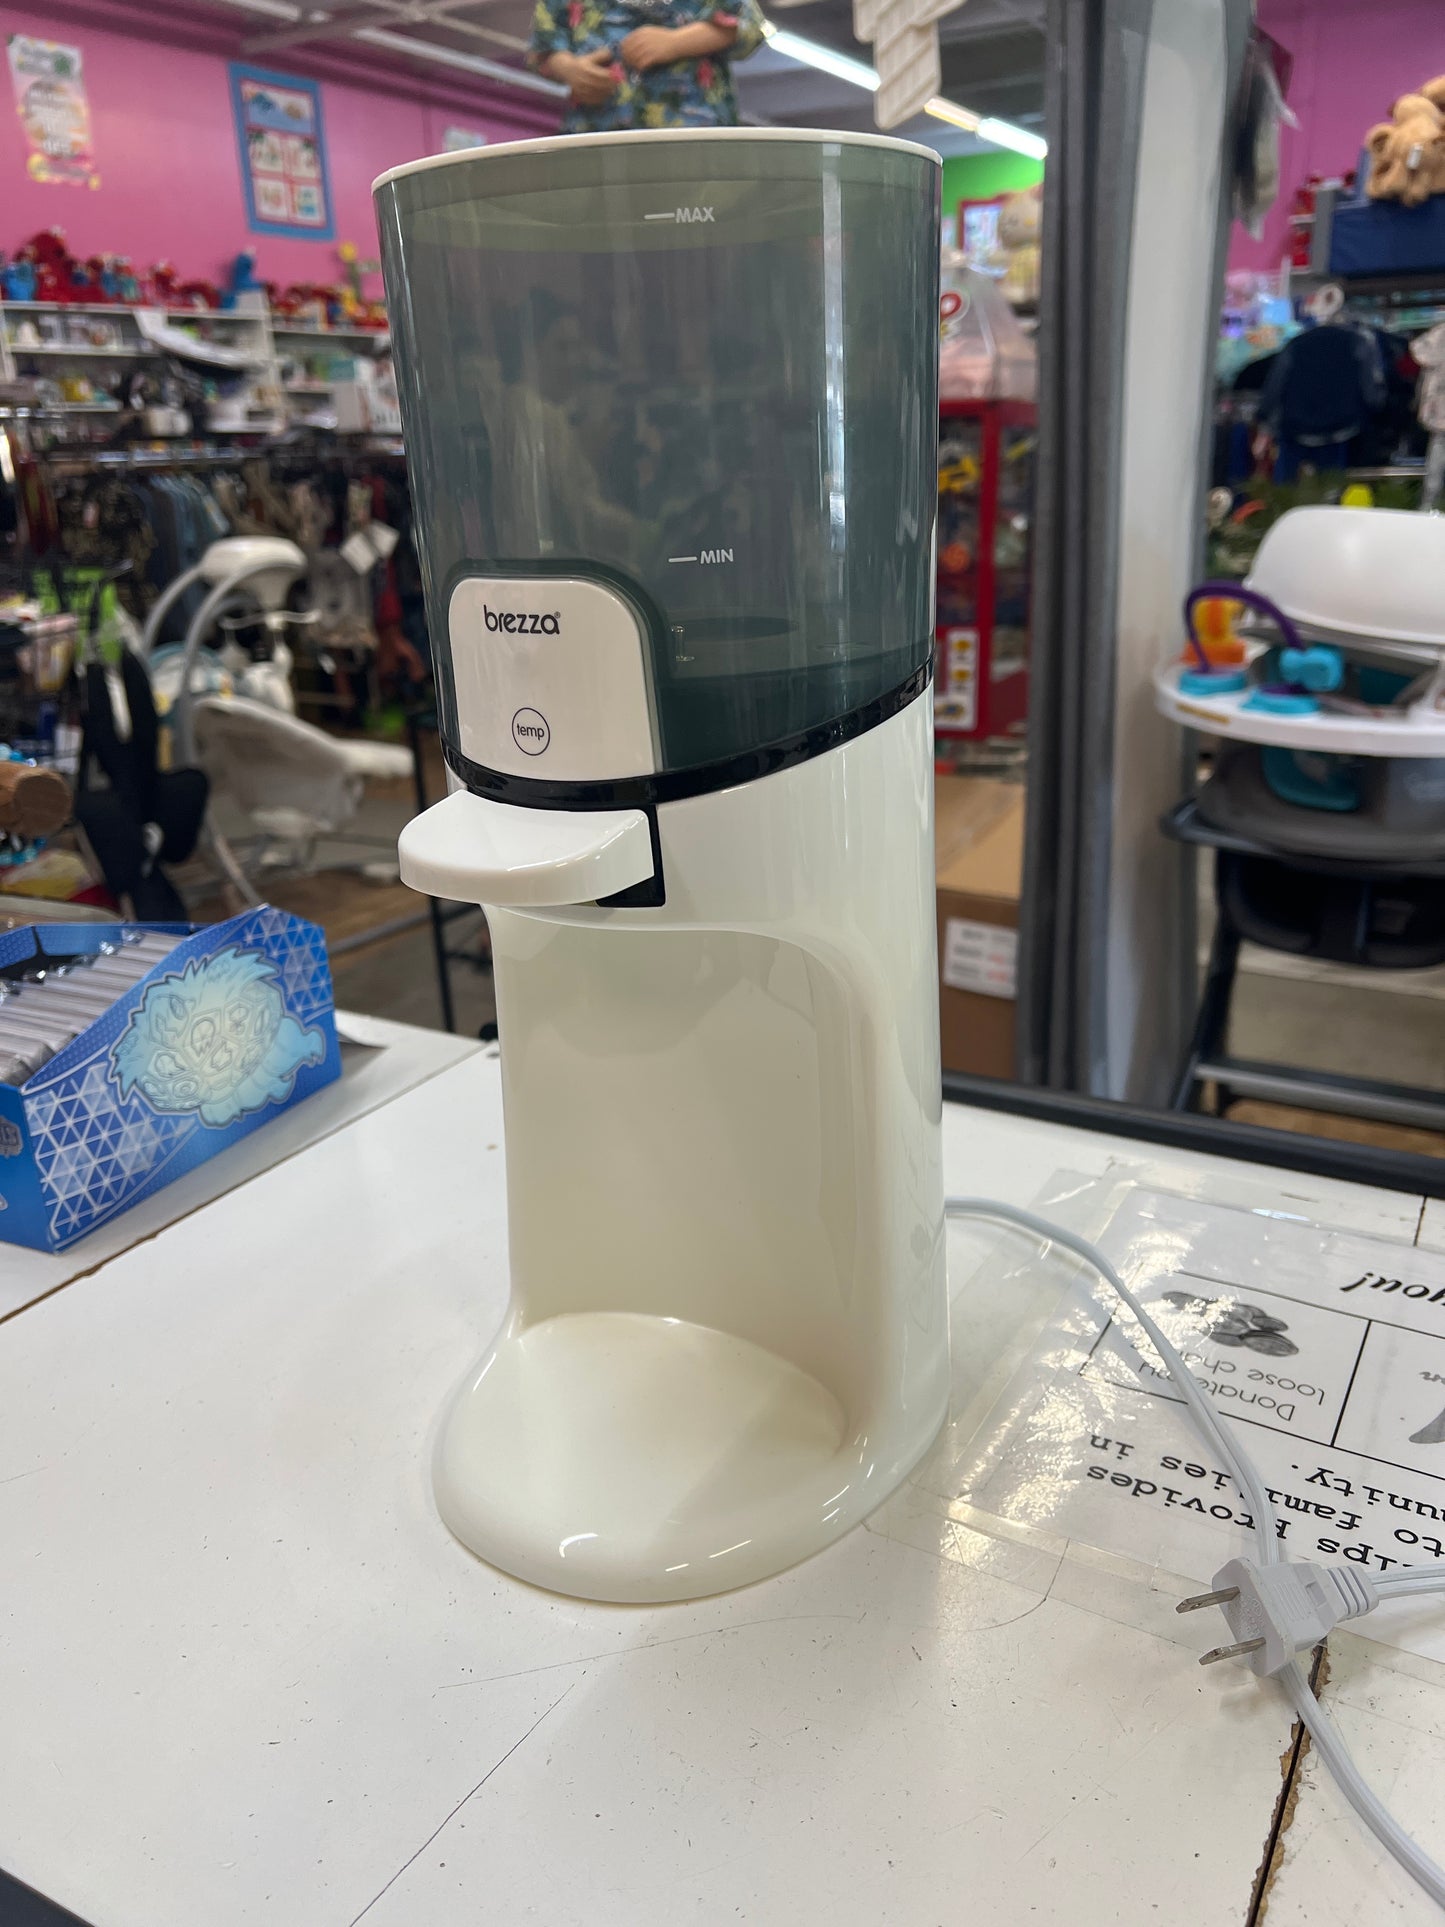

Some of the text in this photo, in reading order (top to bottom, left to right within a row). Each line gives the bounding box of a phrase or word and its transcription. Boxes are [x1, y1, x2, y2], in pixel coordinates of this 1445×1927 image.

[676, 207, 715, 223] MAX
[700, 548, 734, 564] MIN
[516, 723, 545, 741] temp
[1247, 1369, 1324, 1405] loose
[1090, 1435, 1134, 1460] in
[1160, 1456, 1362, 1530] famiies
[1291, 1465, 1445, 1522] unity.
